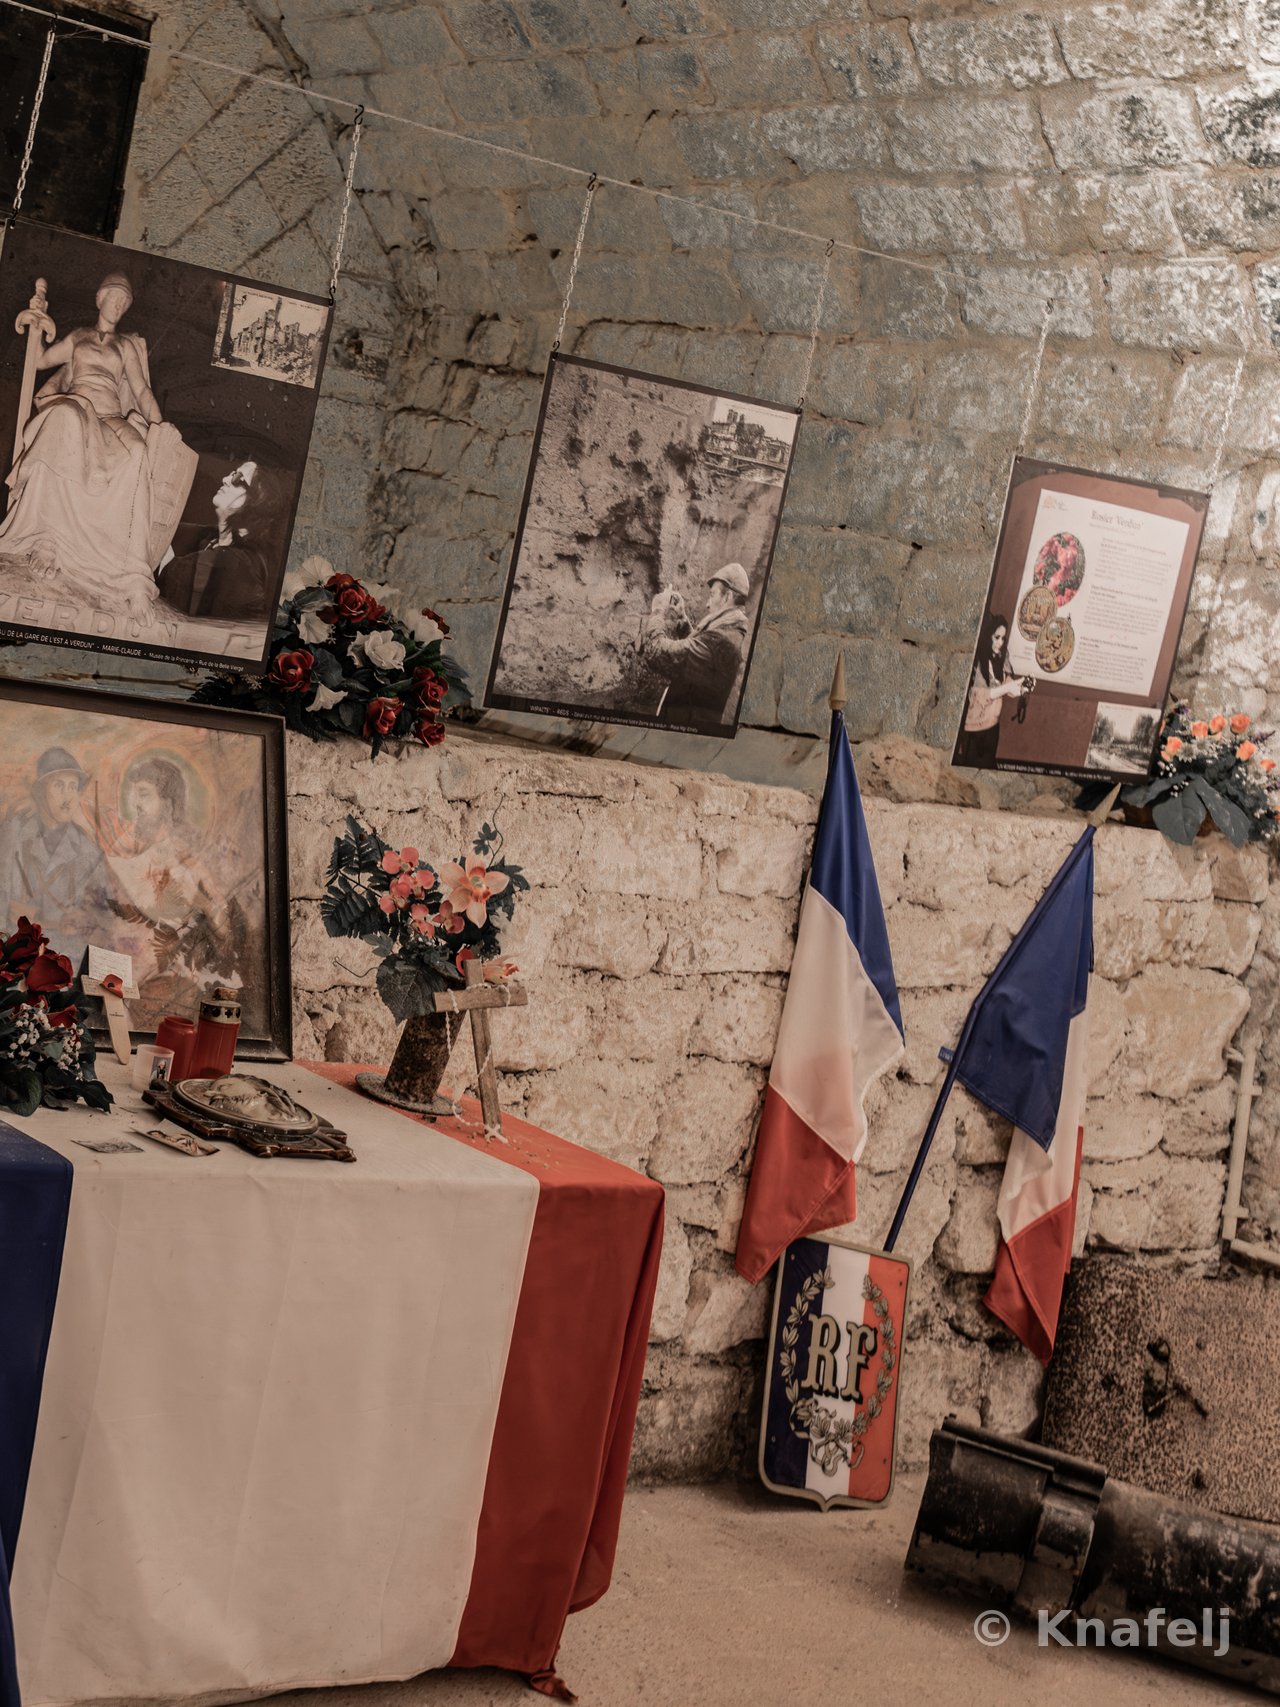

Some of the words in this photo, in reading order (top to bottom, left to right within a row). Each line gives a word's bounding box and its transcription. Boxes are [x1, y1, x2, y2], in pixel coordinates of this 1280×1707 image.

[7, 629, 15, 637] DE
[15, 630, 24, 639] LA
[24, 632, 40, 641] GARE
[41, 634, 49, 643] DE
[49, 635, 64, 645] L'EST
[102, 644, 142, 656] MARIE-CLAUDE
[219, 662, 230, 670] Belle
[800, 1313, 878, 1404] RF
